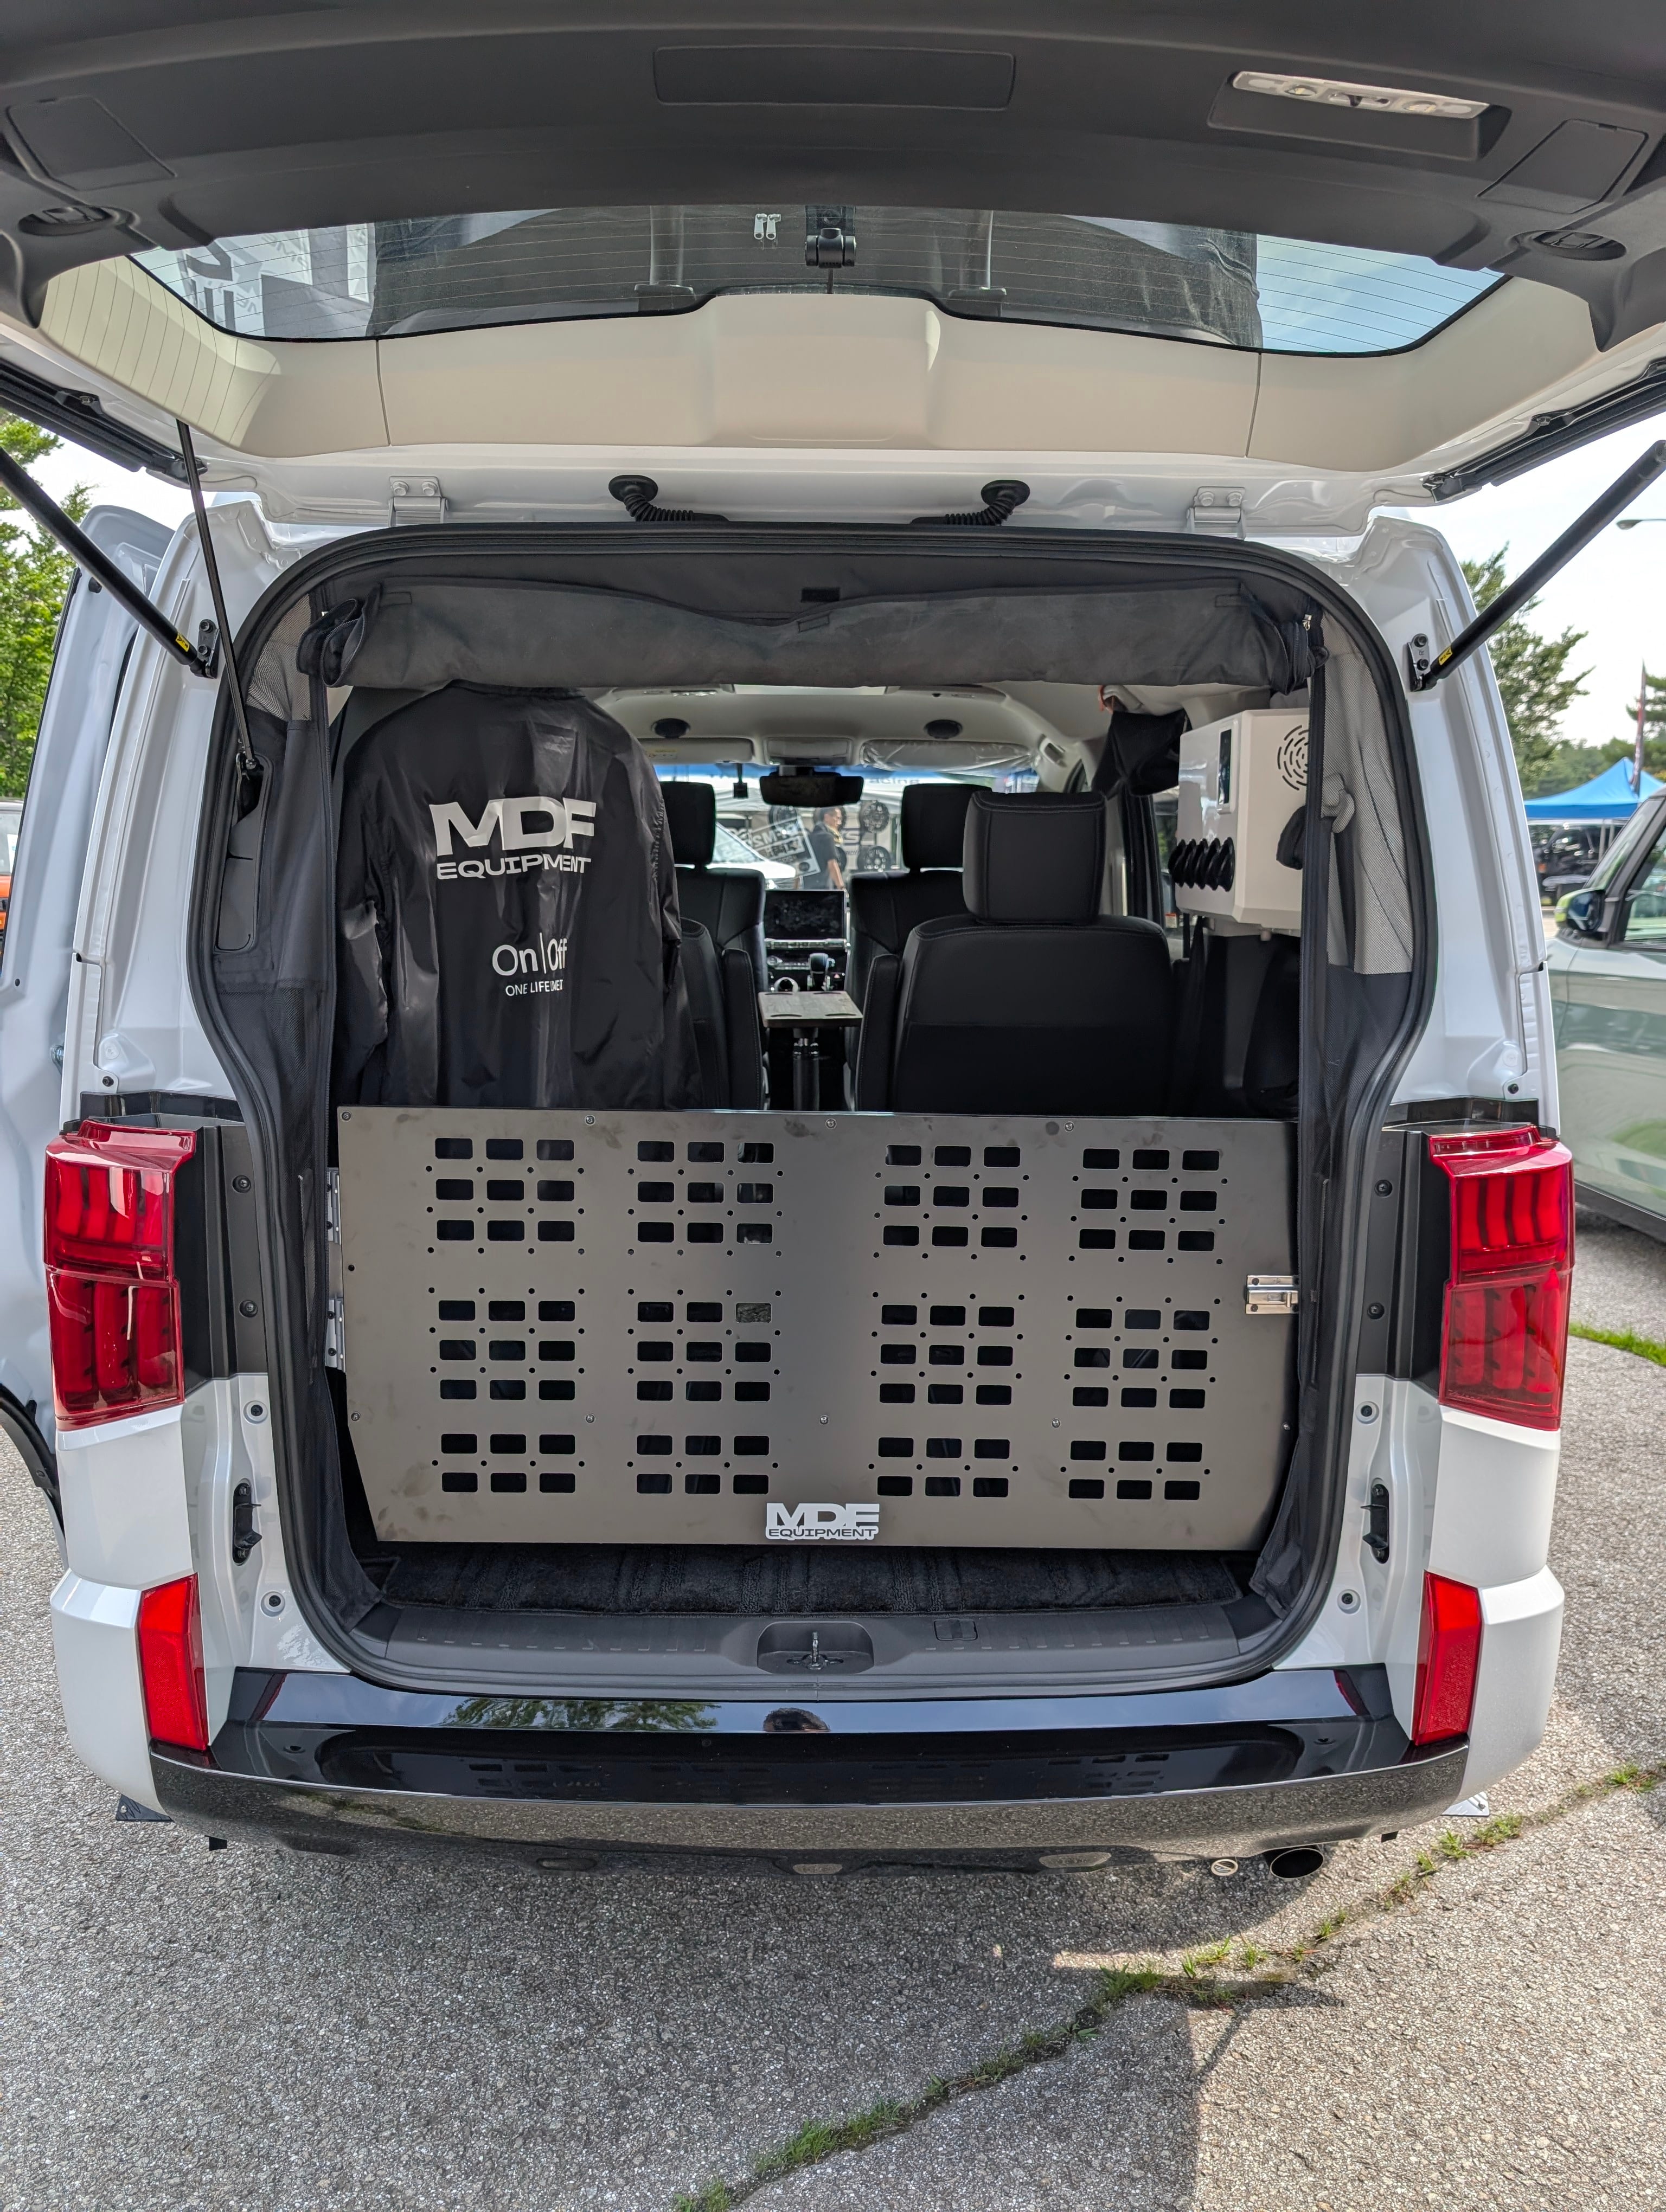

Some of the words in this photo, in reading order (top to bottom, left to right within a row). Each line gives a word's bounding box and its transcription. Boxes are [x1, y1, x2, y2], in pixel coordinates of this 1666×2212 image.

[429, 796, 597, 856] MDF
[437, 853, 592, 880] EQUIPMENT
[505, 983, 528, 996] ONE
[530, 981, 550, 993] LIFE
[766, 1503, 880, 1526] MDF
[768, 1528, 876, 1537] EQUIPMENT
